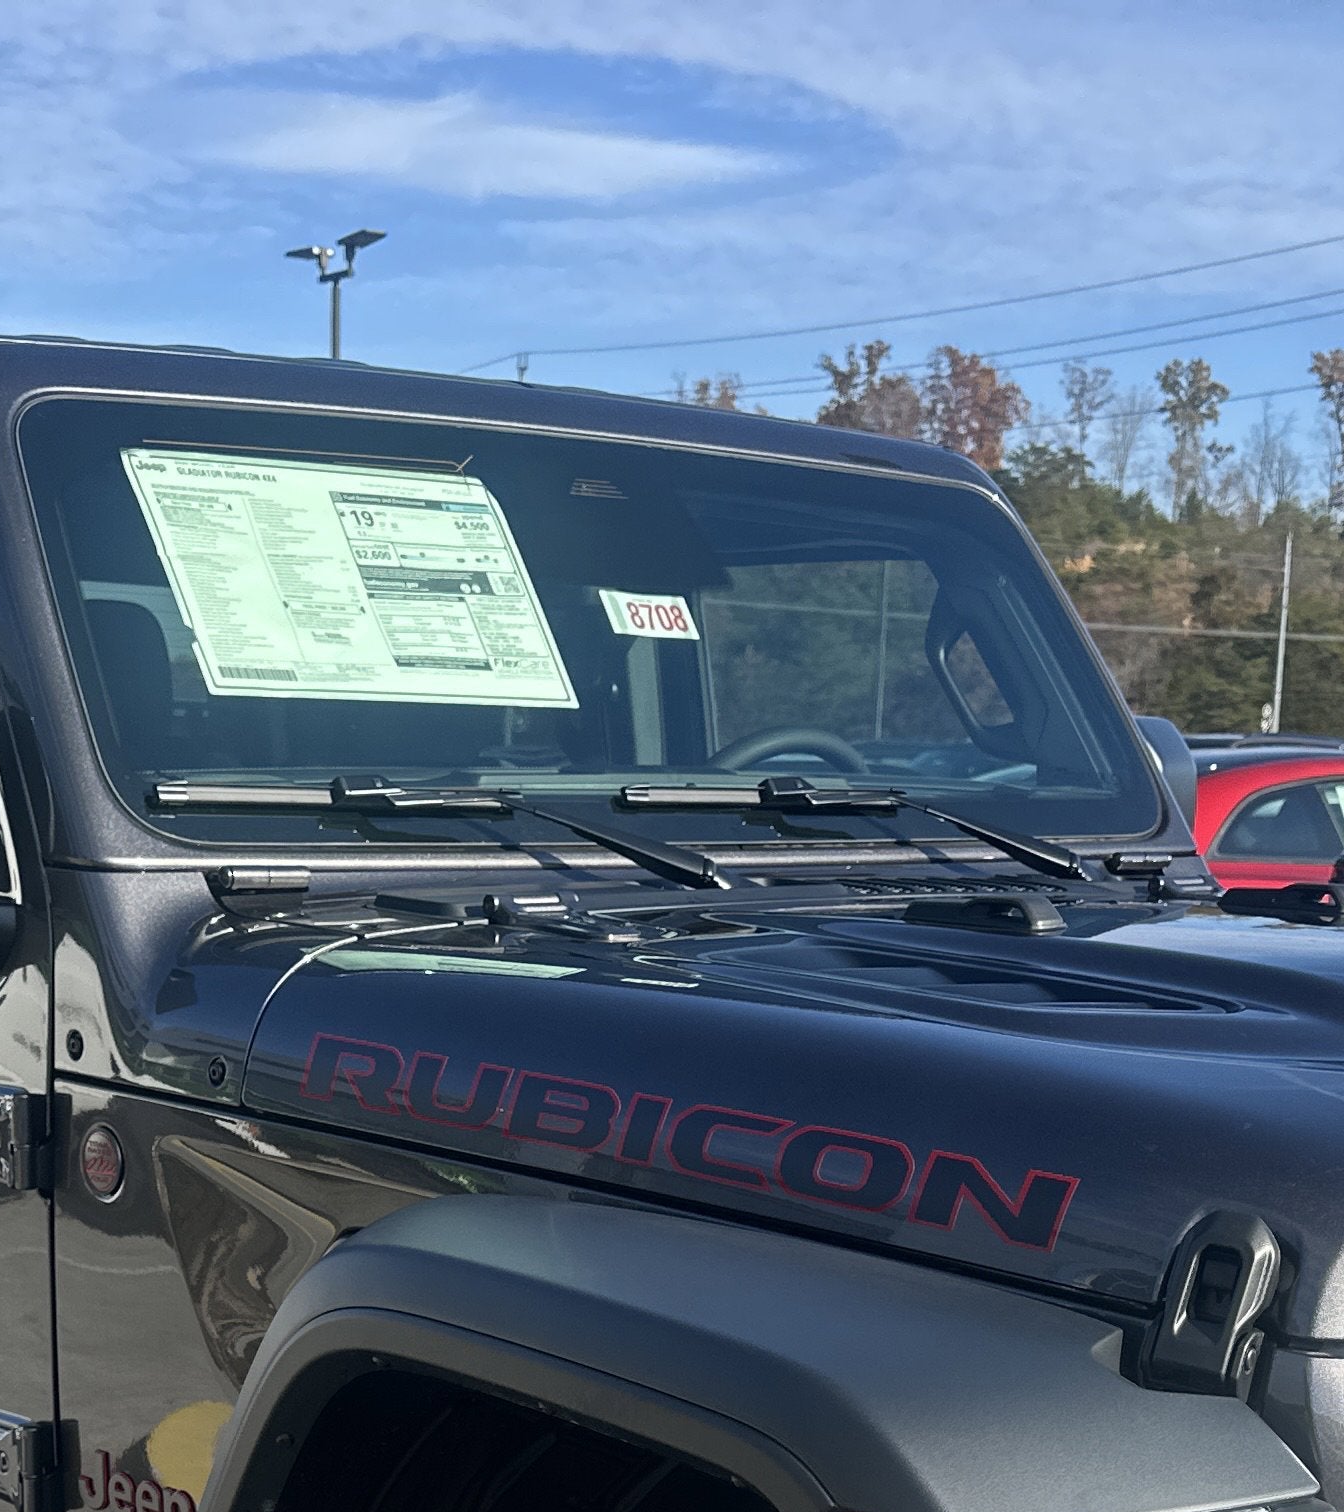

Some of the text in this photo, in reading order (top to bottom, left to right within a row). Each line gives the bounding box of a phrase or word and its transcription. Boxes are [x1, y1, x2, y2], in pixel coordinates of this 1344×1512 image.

[135, 460, 167, 473] Jeep
[176, 466, 223, 479] GLADIATOR
[224, 471, 261, 482] RUBICON
[349, 510, 375, 527] 19
[626, 602, 689, 632] 8708
[301, 1033, 1080, 1252] RUBICON
